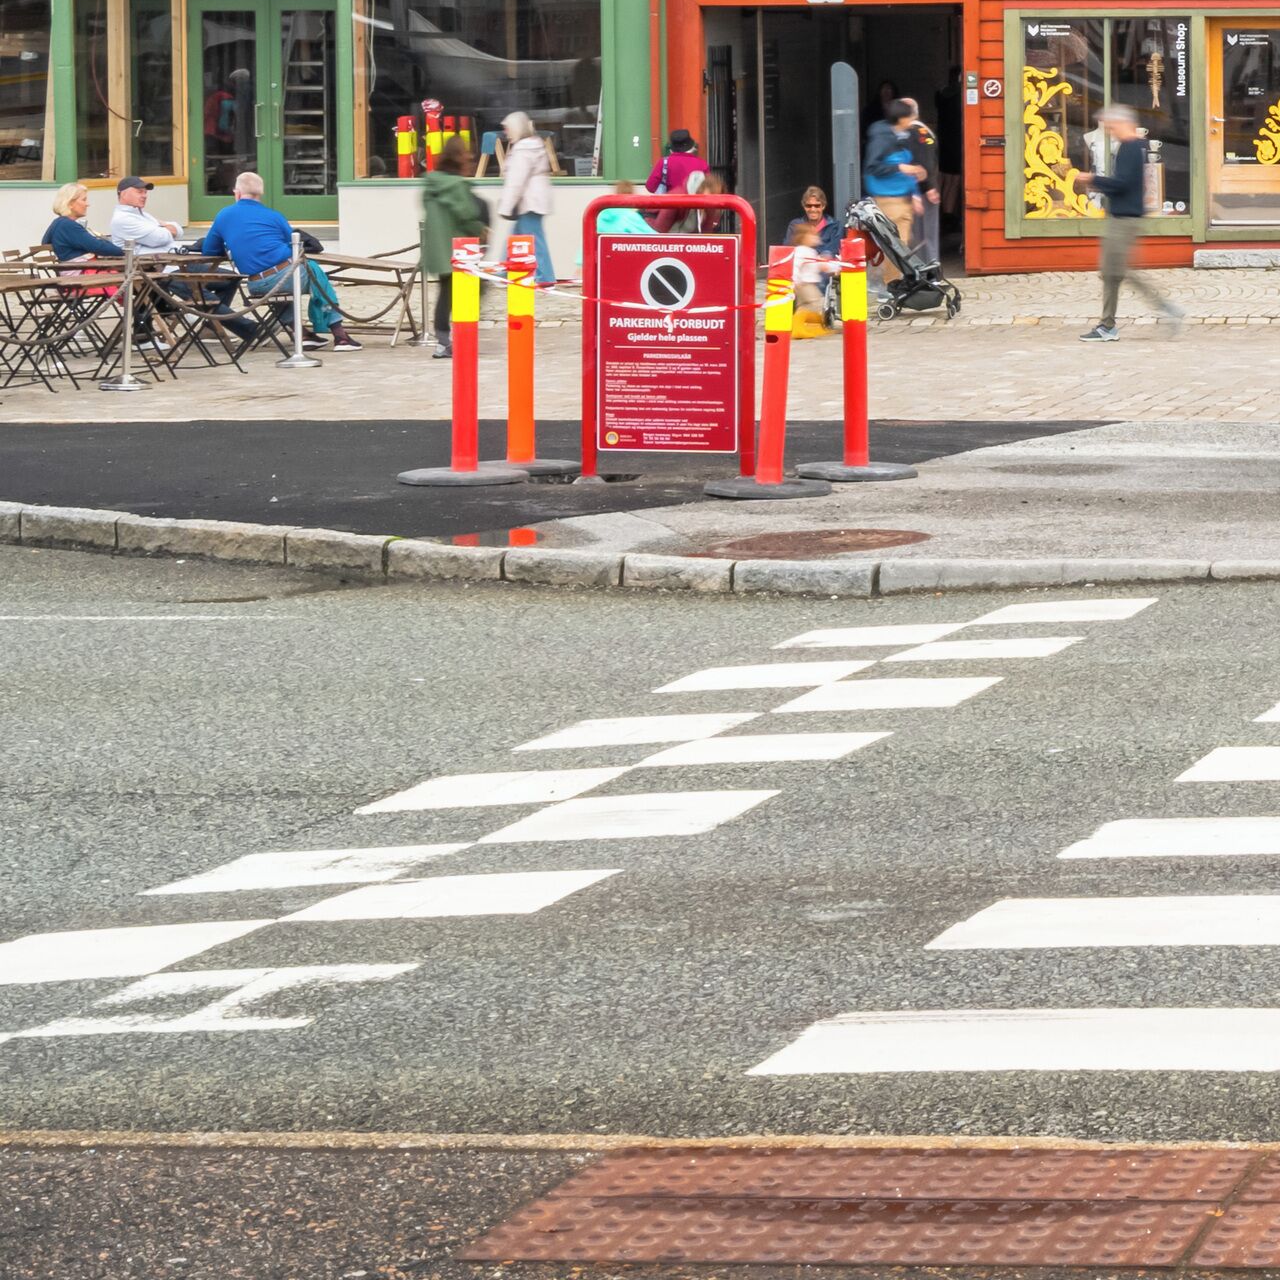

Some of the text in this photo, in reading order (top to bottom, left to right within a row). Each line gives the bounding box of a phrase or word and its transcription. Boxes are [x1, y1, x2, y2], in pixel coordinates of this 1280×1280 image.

[1176, 23, 1188, 97] Museum Shop
[611, 242, 724, 254] PRIVATREGULERT OMRÅDE
[673, 318, 726, 330] FORBUDT
[627, 332, 708, 343] Gjelder hele plassen
